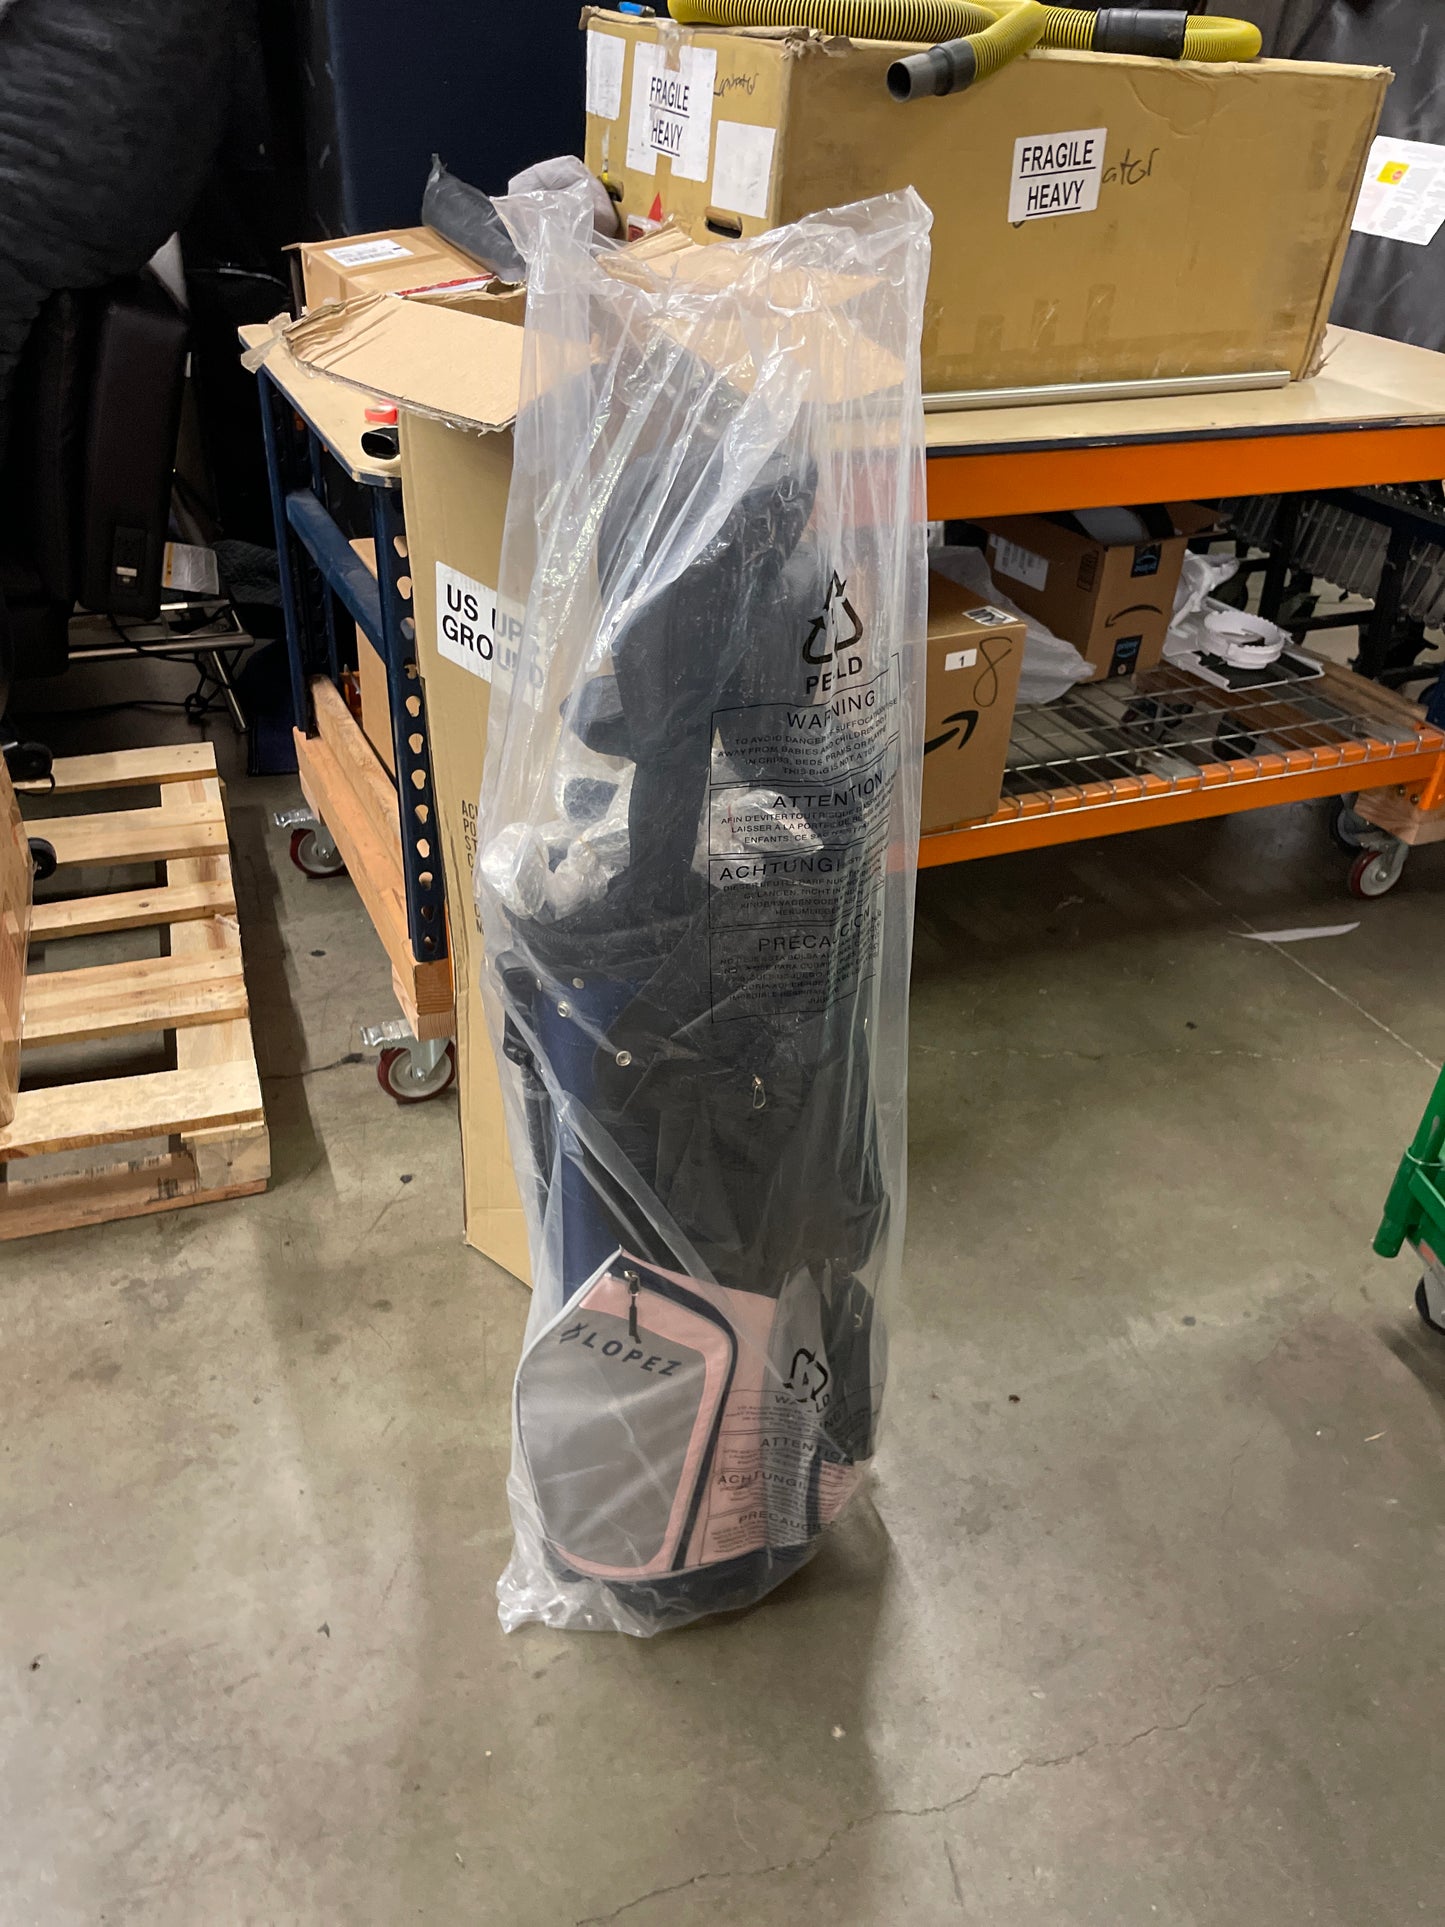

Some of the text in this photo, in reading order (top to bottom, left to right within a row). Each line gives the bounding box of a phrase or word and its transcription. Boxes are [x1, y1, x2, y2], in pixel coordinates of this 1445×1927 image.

[649, 77, 690, 112] FRAGILE
[651, 119, 683, 152] HEAVY
[1020, 140, 1094, 173] FRAGILE
[1027, 179, 1085, 211] HEAVY
[446, 583, 479, 622] US
[958, 655, 966, 667] 1
[973, 636, 1013, 708] 8
[772, 769, 883, 809] ATTENTION
[719, 857, 840, 881] ACHTUNG!
